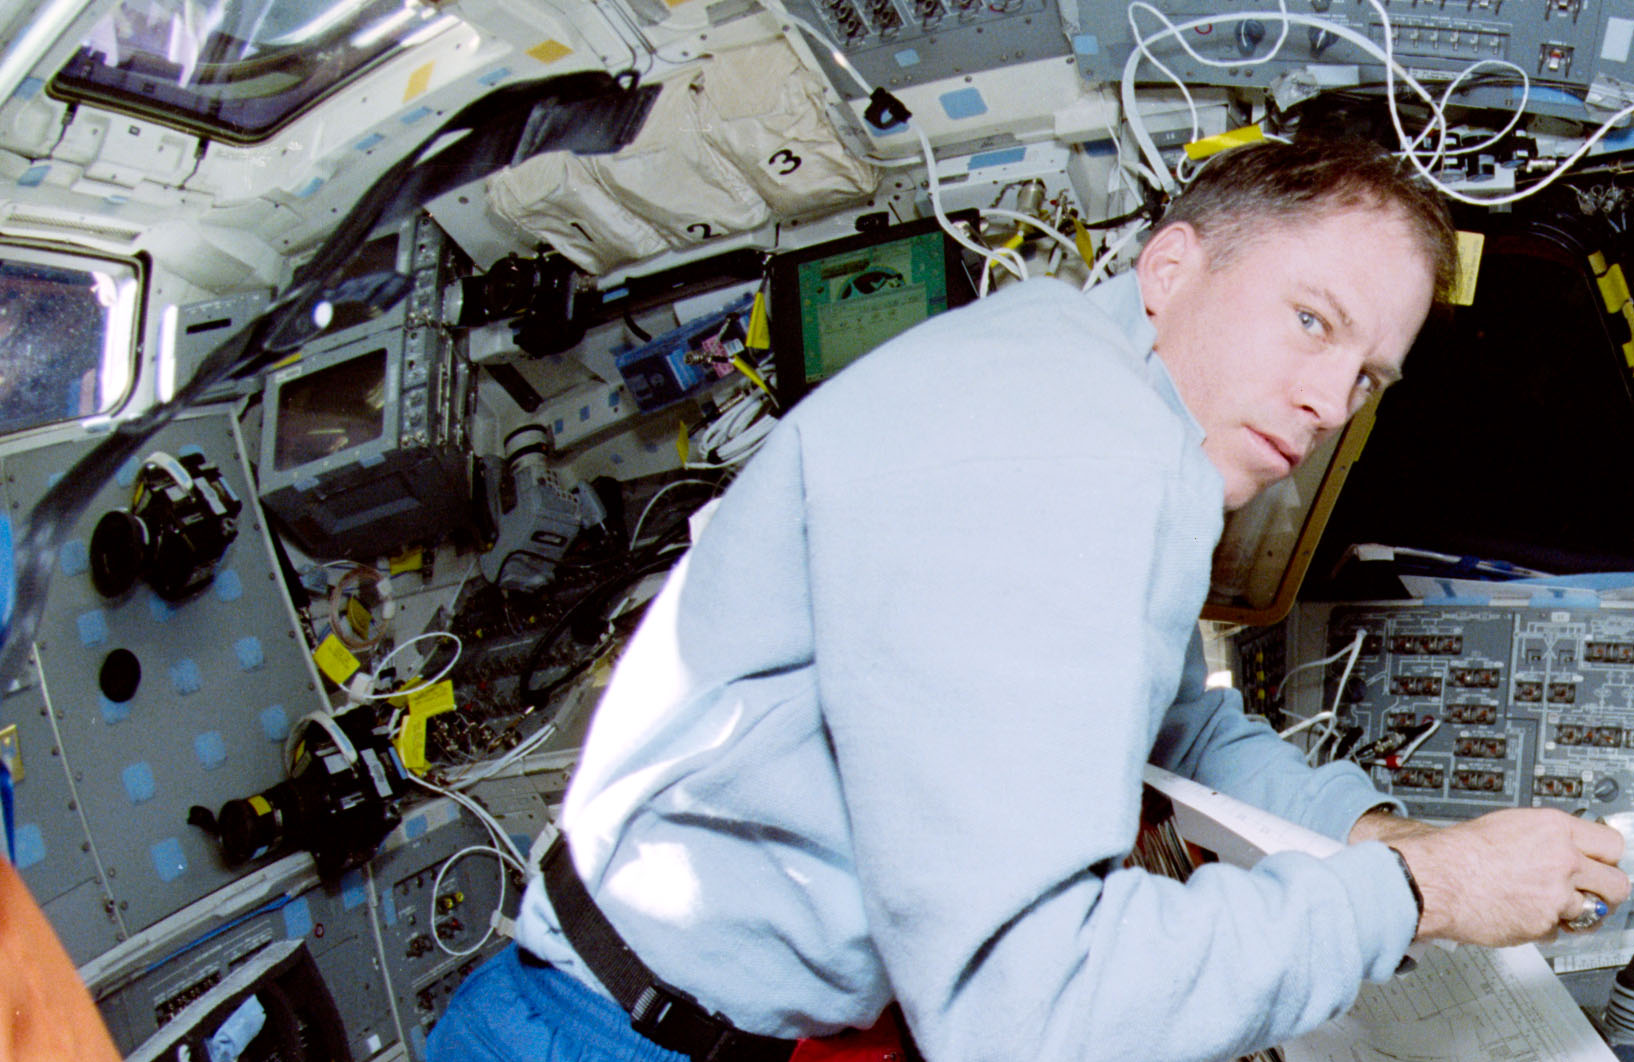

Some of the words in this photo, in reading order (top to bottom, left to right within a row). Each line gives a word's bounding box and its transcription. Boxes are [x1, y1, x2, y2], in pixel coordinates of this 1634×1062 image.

[768, 148, 802, 175] 3
[570, 222, 593, 241] 1
[687, 222, 722, 240] 2
